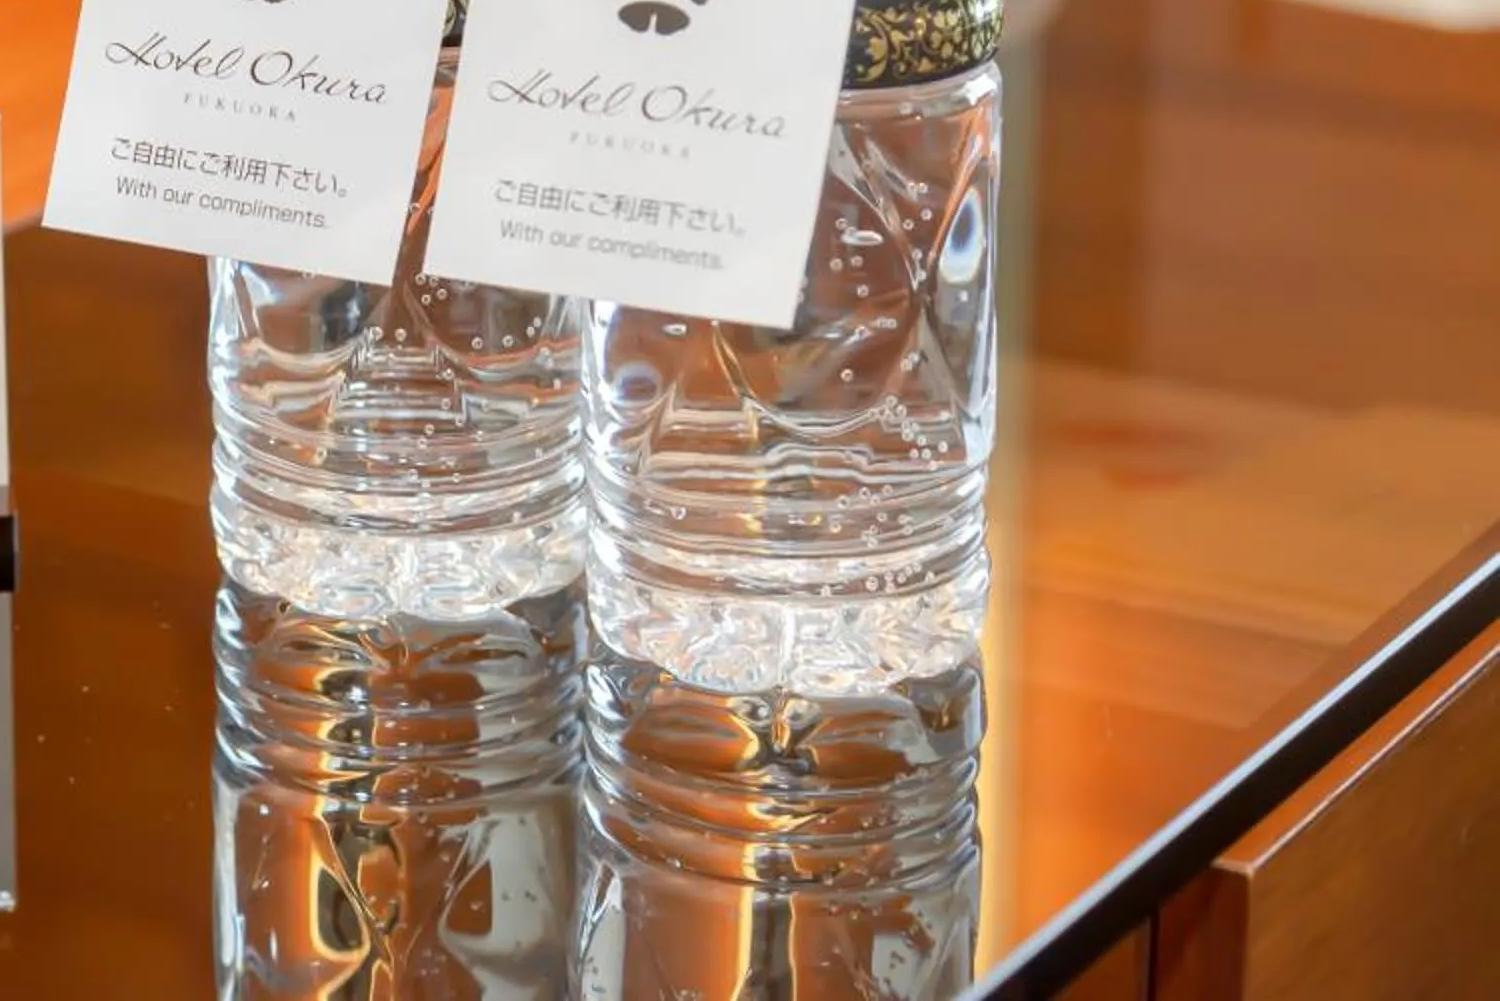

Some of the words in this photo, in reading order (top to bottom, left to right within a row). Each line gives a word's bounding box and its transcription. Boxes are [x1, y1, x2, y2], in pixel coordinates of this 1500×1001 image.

[105, 32, 245, 80] Hotel
[250, 50, 387, 104] Okura
[184, 93, 297, 122] FUKUOKA
[487, 69, 636, 116] Hotel
[641, 85, 787, 138] Okura
[111, 138, 347, 198] ご自由にご利用下さい。
[116, 175, 157, 199] With
[162, 187, 194, 205] our
[500, 218, 543, 244] With
[549, 230, 583, 248] our
